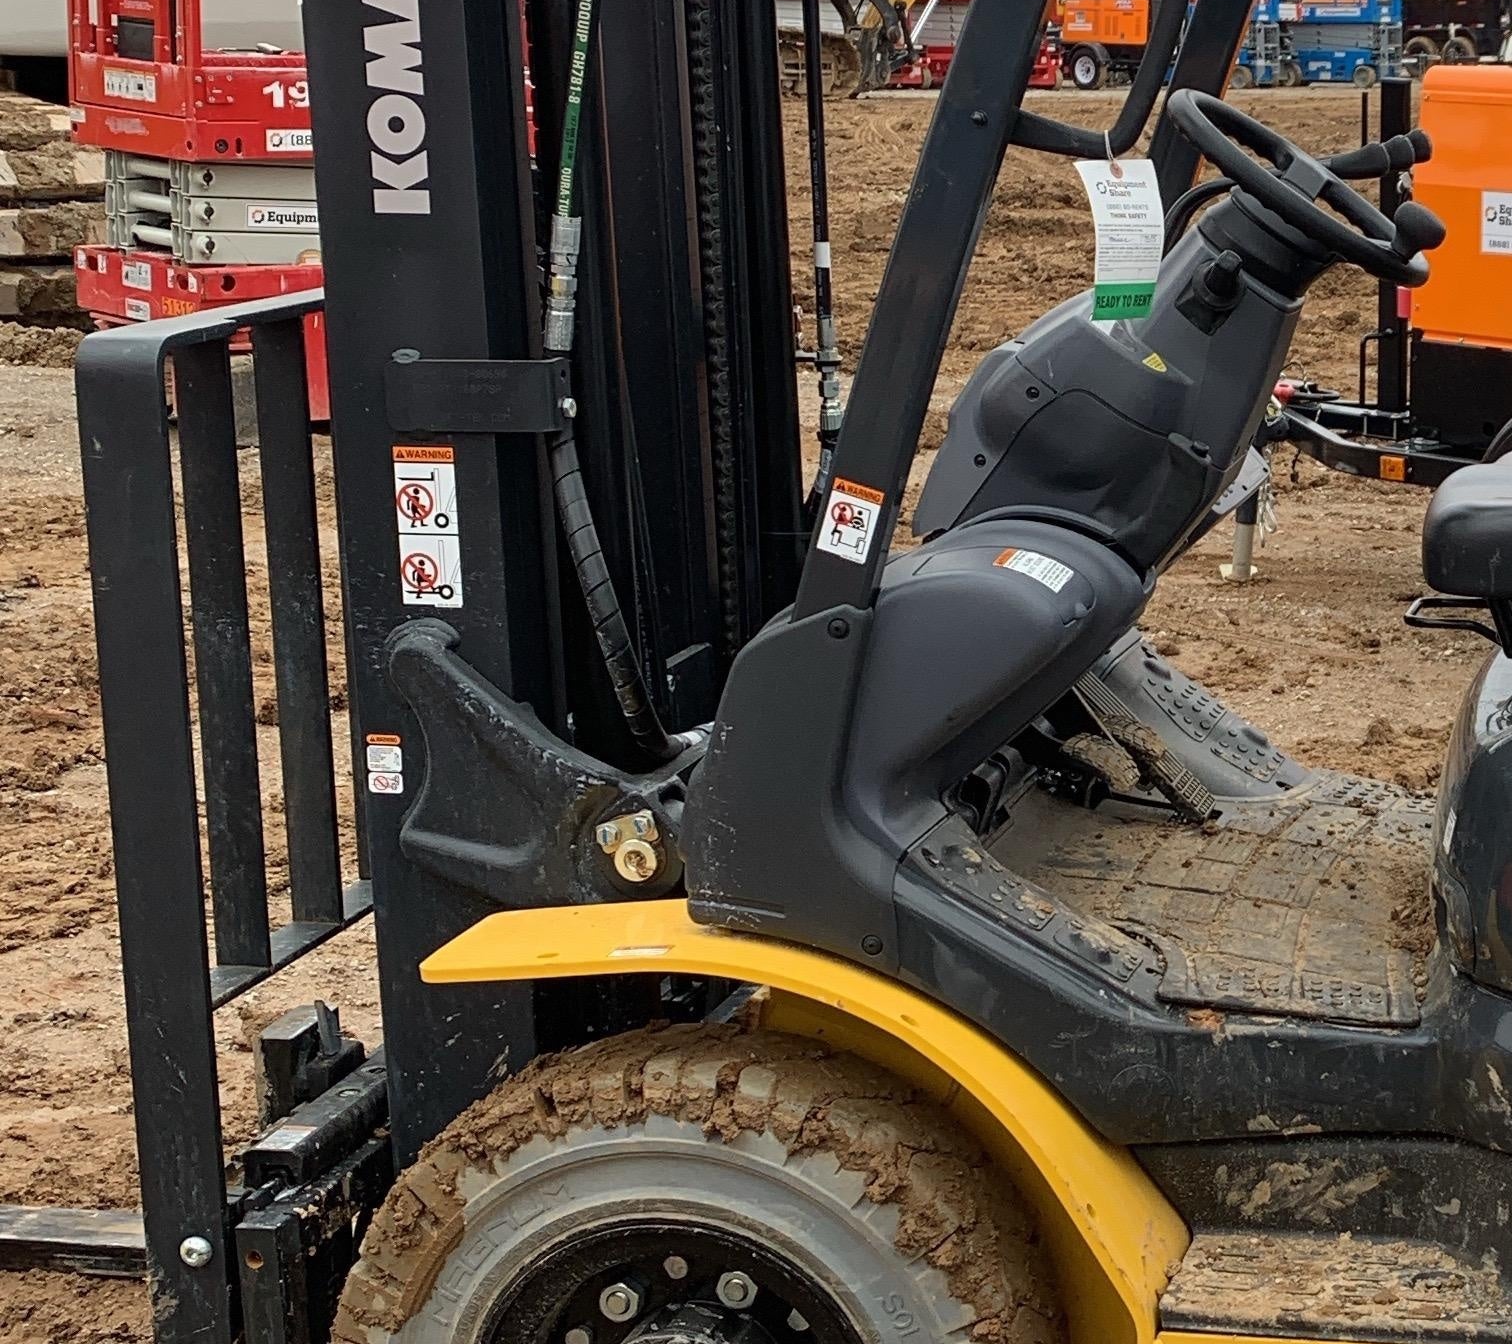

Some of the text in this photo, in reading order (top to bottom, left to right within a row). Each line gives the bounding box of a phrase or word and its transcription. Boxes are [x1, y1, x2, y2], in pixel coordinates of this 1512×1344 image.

[568, 50, 586, 105] GH781-8
[1096, 294, 1153, 309] READY TO RENT
[404, 449, 453, 460] WARNING
[846, 485, 881, 503] WARNING
